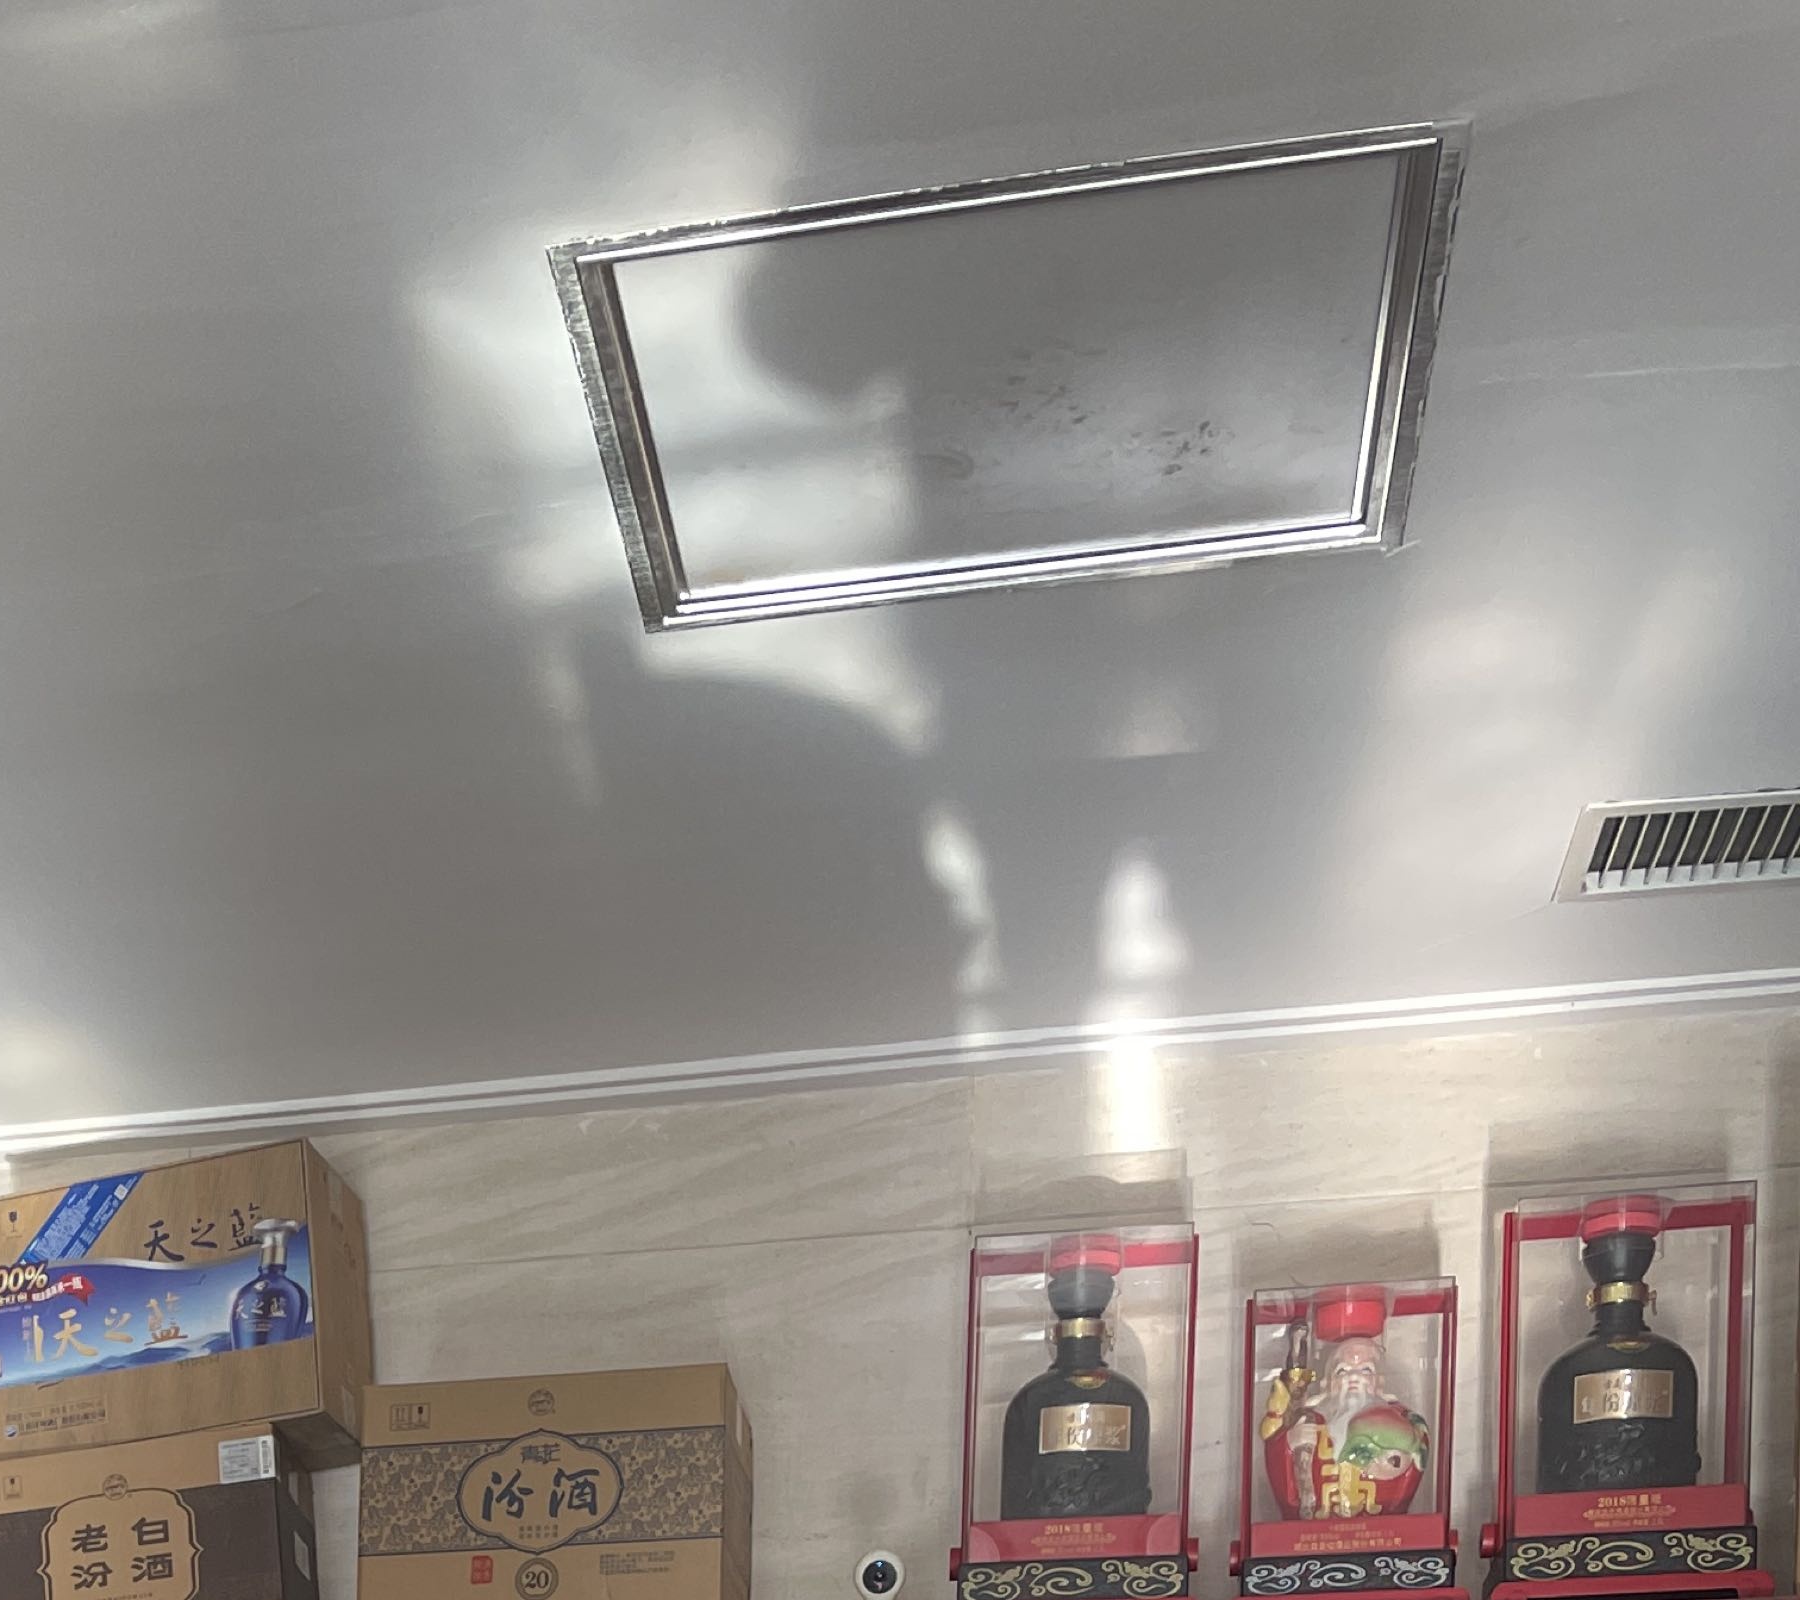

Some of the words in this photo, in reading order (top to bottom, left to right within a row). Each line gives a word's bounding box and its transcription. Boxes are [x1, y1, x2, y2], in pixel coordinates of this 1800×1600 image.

[481, 1468, 599, 1521] 汾酒
[72, 1553, 174, 1590] 汾酒
[524, 1570, 549, 1589] 20
